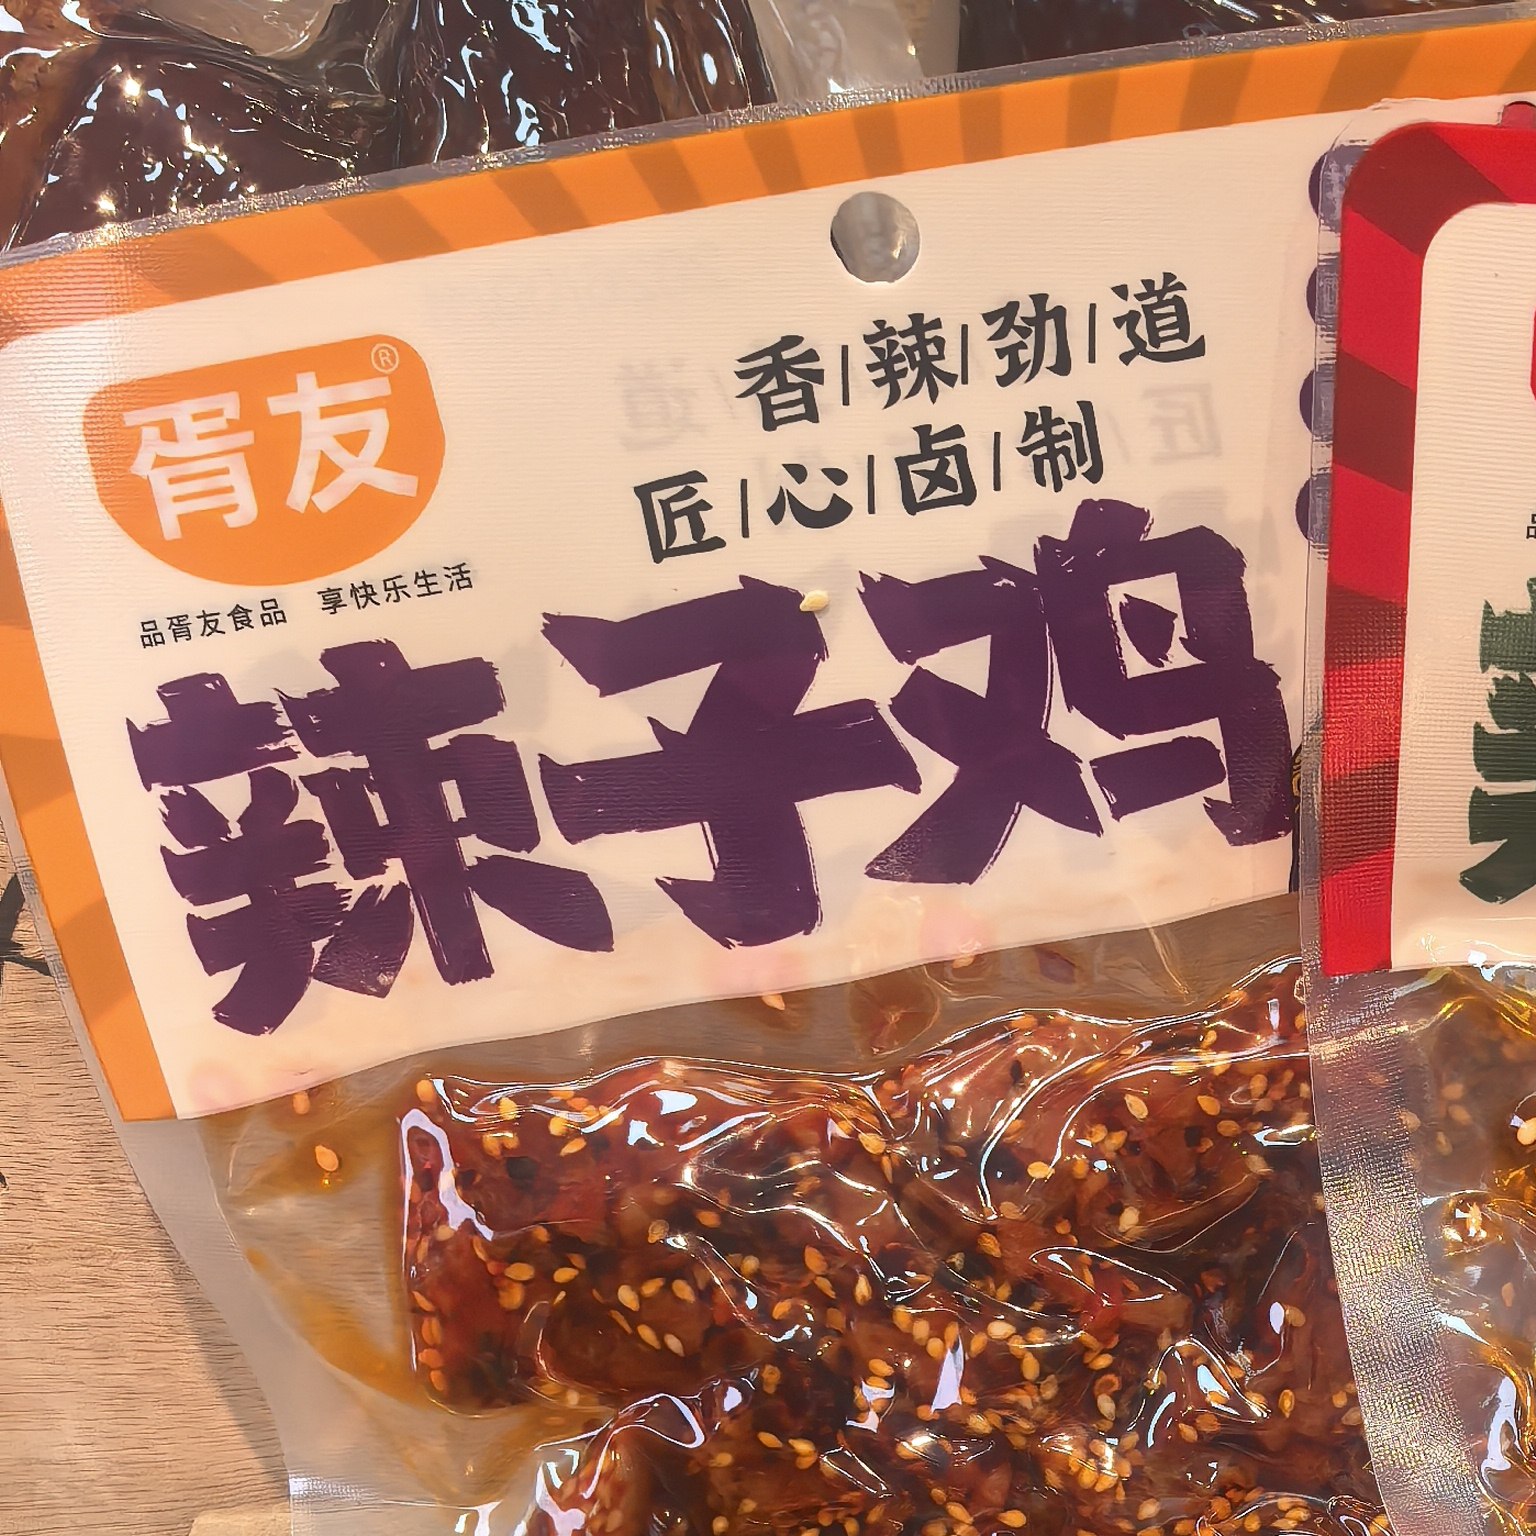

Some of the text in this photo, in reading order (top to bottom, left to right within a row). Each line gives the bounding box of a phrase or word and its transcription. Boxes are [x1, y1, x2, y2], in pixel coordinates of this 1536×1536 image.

[121, 371, 419, 542] 胥友
[139, 562, 476, 648] 品胥友食品 享快乐生活
[126, 498, 1299, 1036] 辣子鸡
